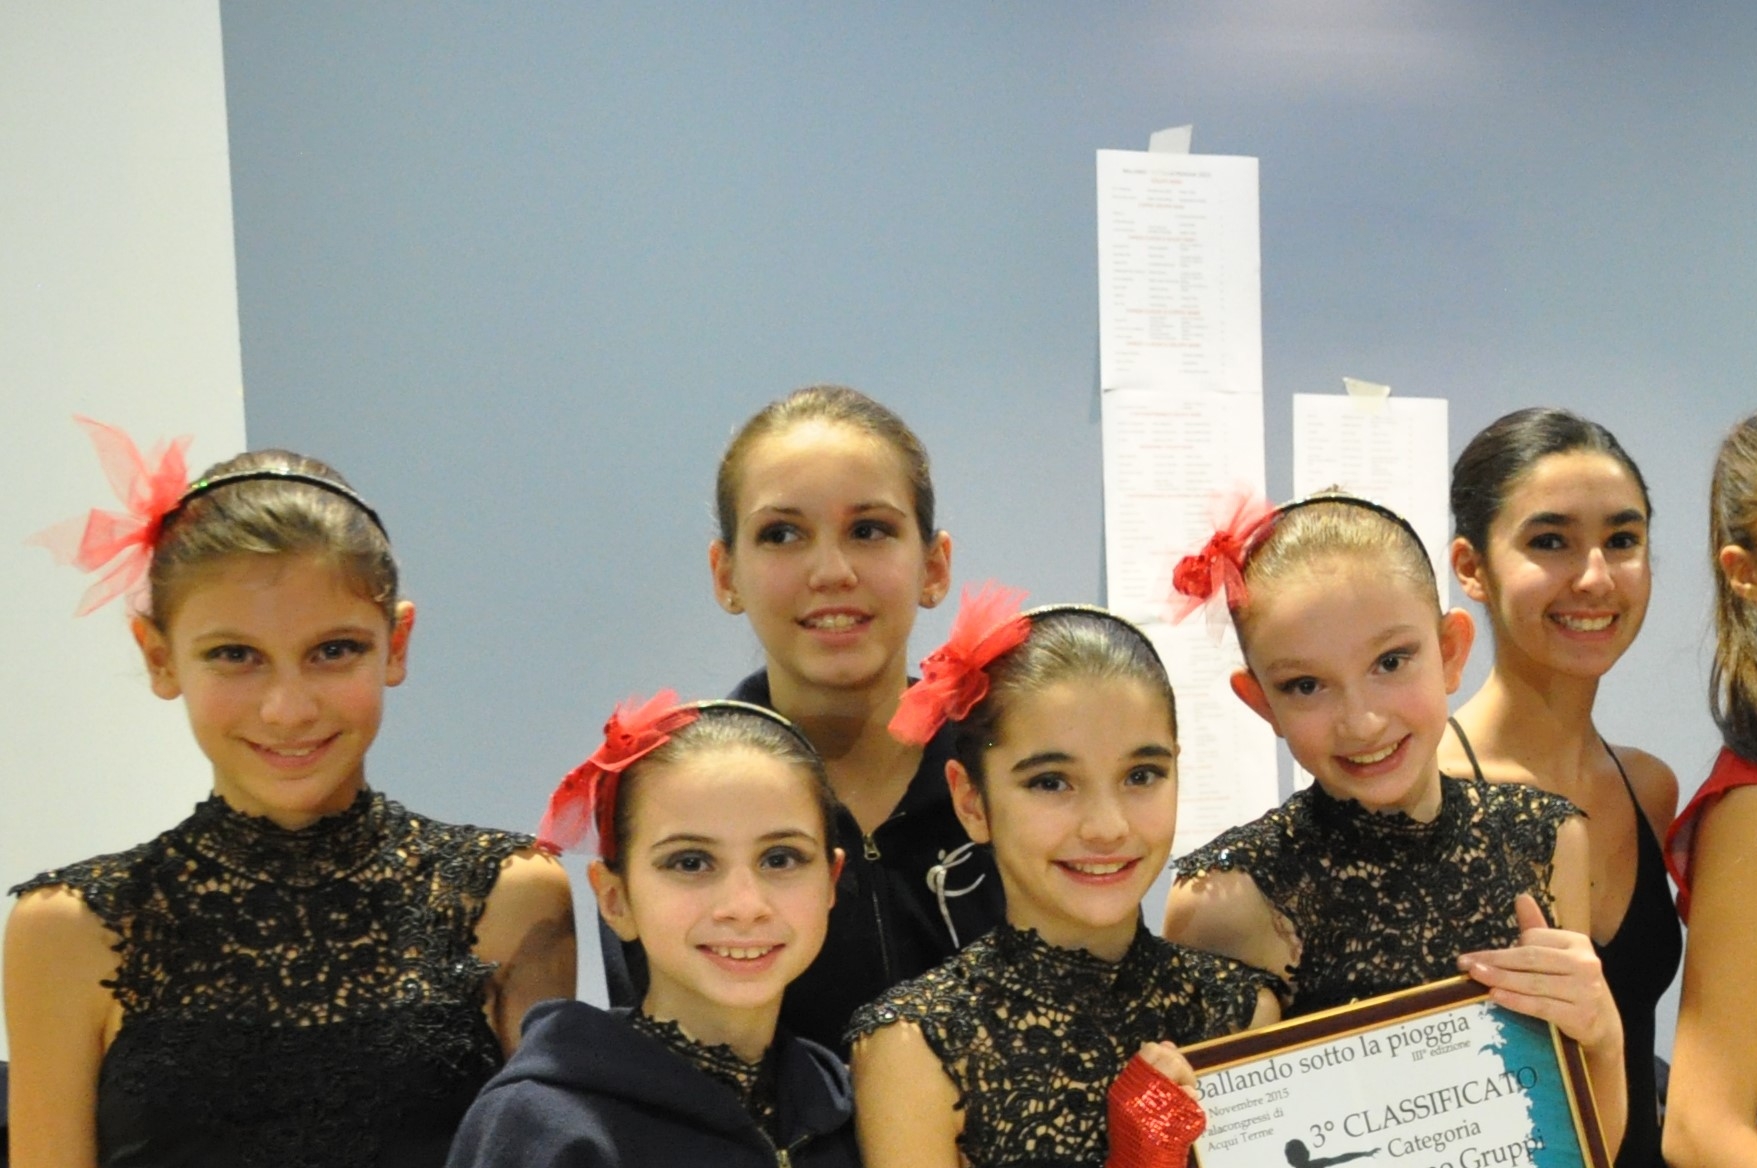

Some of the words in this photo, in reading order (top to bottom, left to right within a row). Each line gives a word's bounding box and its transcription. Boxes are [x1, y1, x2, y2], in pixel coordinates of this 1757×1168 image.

[1300, 1045, 1355, 1073] sotto
[1359, 1036, 1382, 1057] la
[1386, 1013, 1470, 1058] pioggia
[1430, 1040, 1471, 1056] edizione
[1208, 1095, 1264, 1118] Novembre
[1266, 1088, 1290, 1103] 2015
[1273, 1107, 1284, 1119] di
[1309, 1120, 1334, 1149] 3°
[1343, 1066, 1537, 1138] CLASSIFICATO
[1207, 1134, 1239, 1152] Acqui
[1241, 1126, 1274, 1144] Terme
[1387, 1119, 1482, 1158] Categoria
